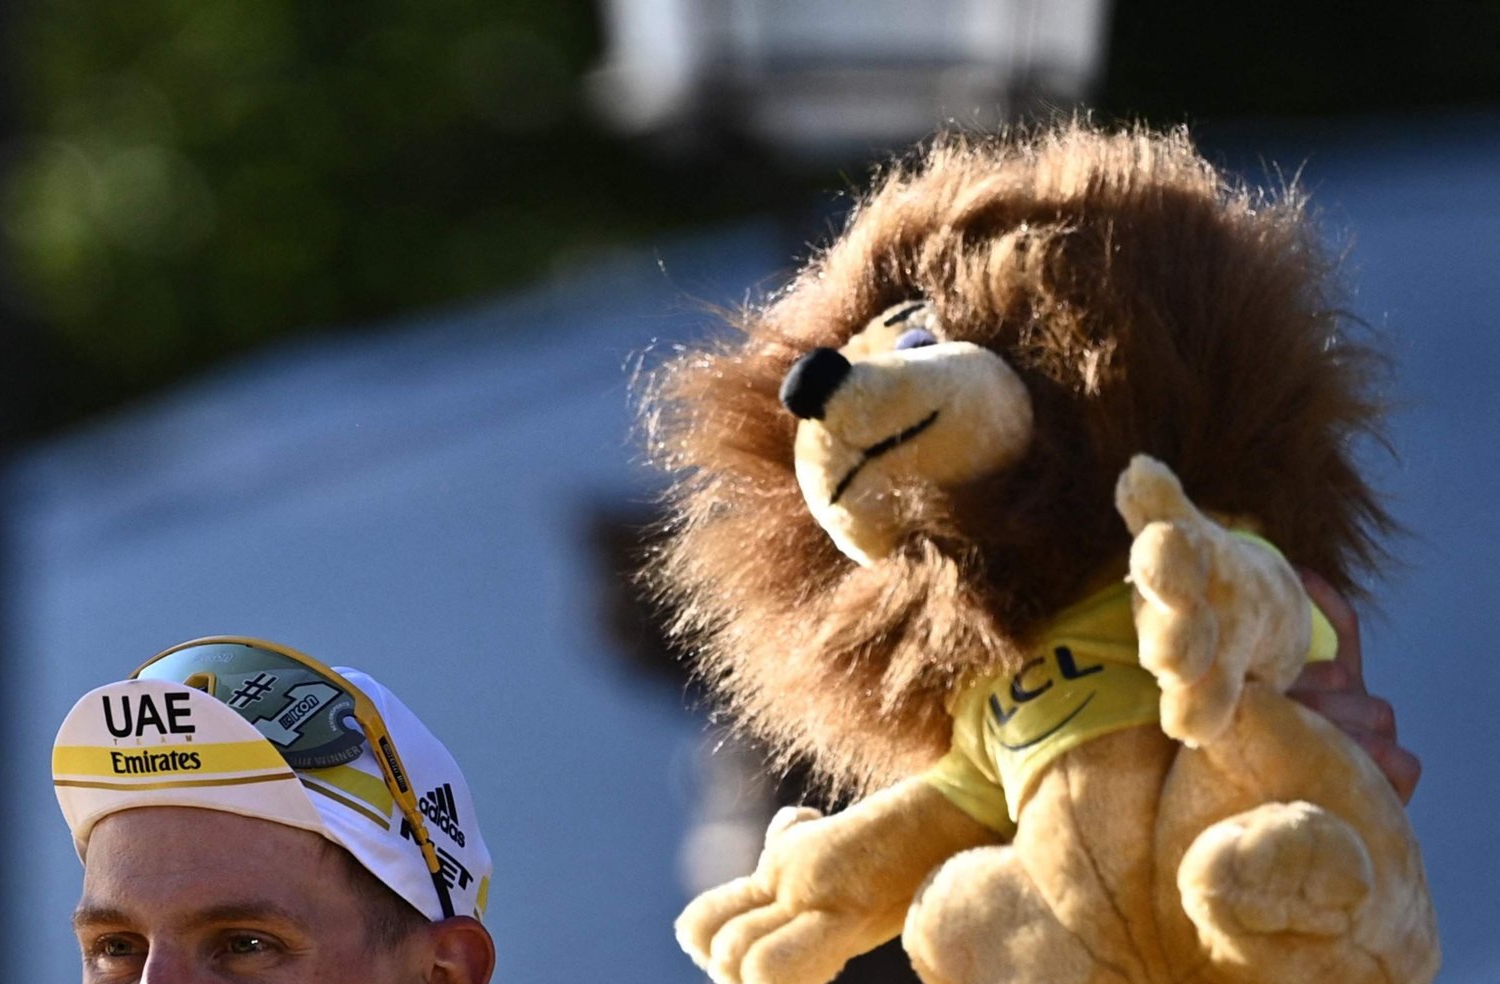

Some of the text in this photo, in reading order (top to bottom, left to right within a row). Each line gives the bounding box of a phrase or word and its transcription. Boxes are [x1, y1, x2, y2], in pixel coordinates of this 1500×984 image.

[987, 644, 1105, 727] LCL
[101, 691, 196, 739] UAE
[109, 749, 202, 774] Emirates
[418, 797, 466, 849] adidas
